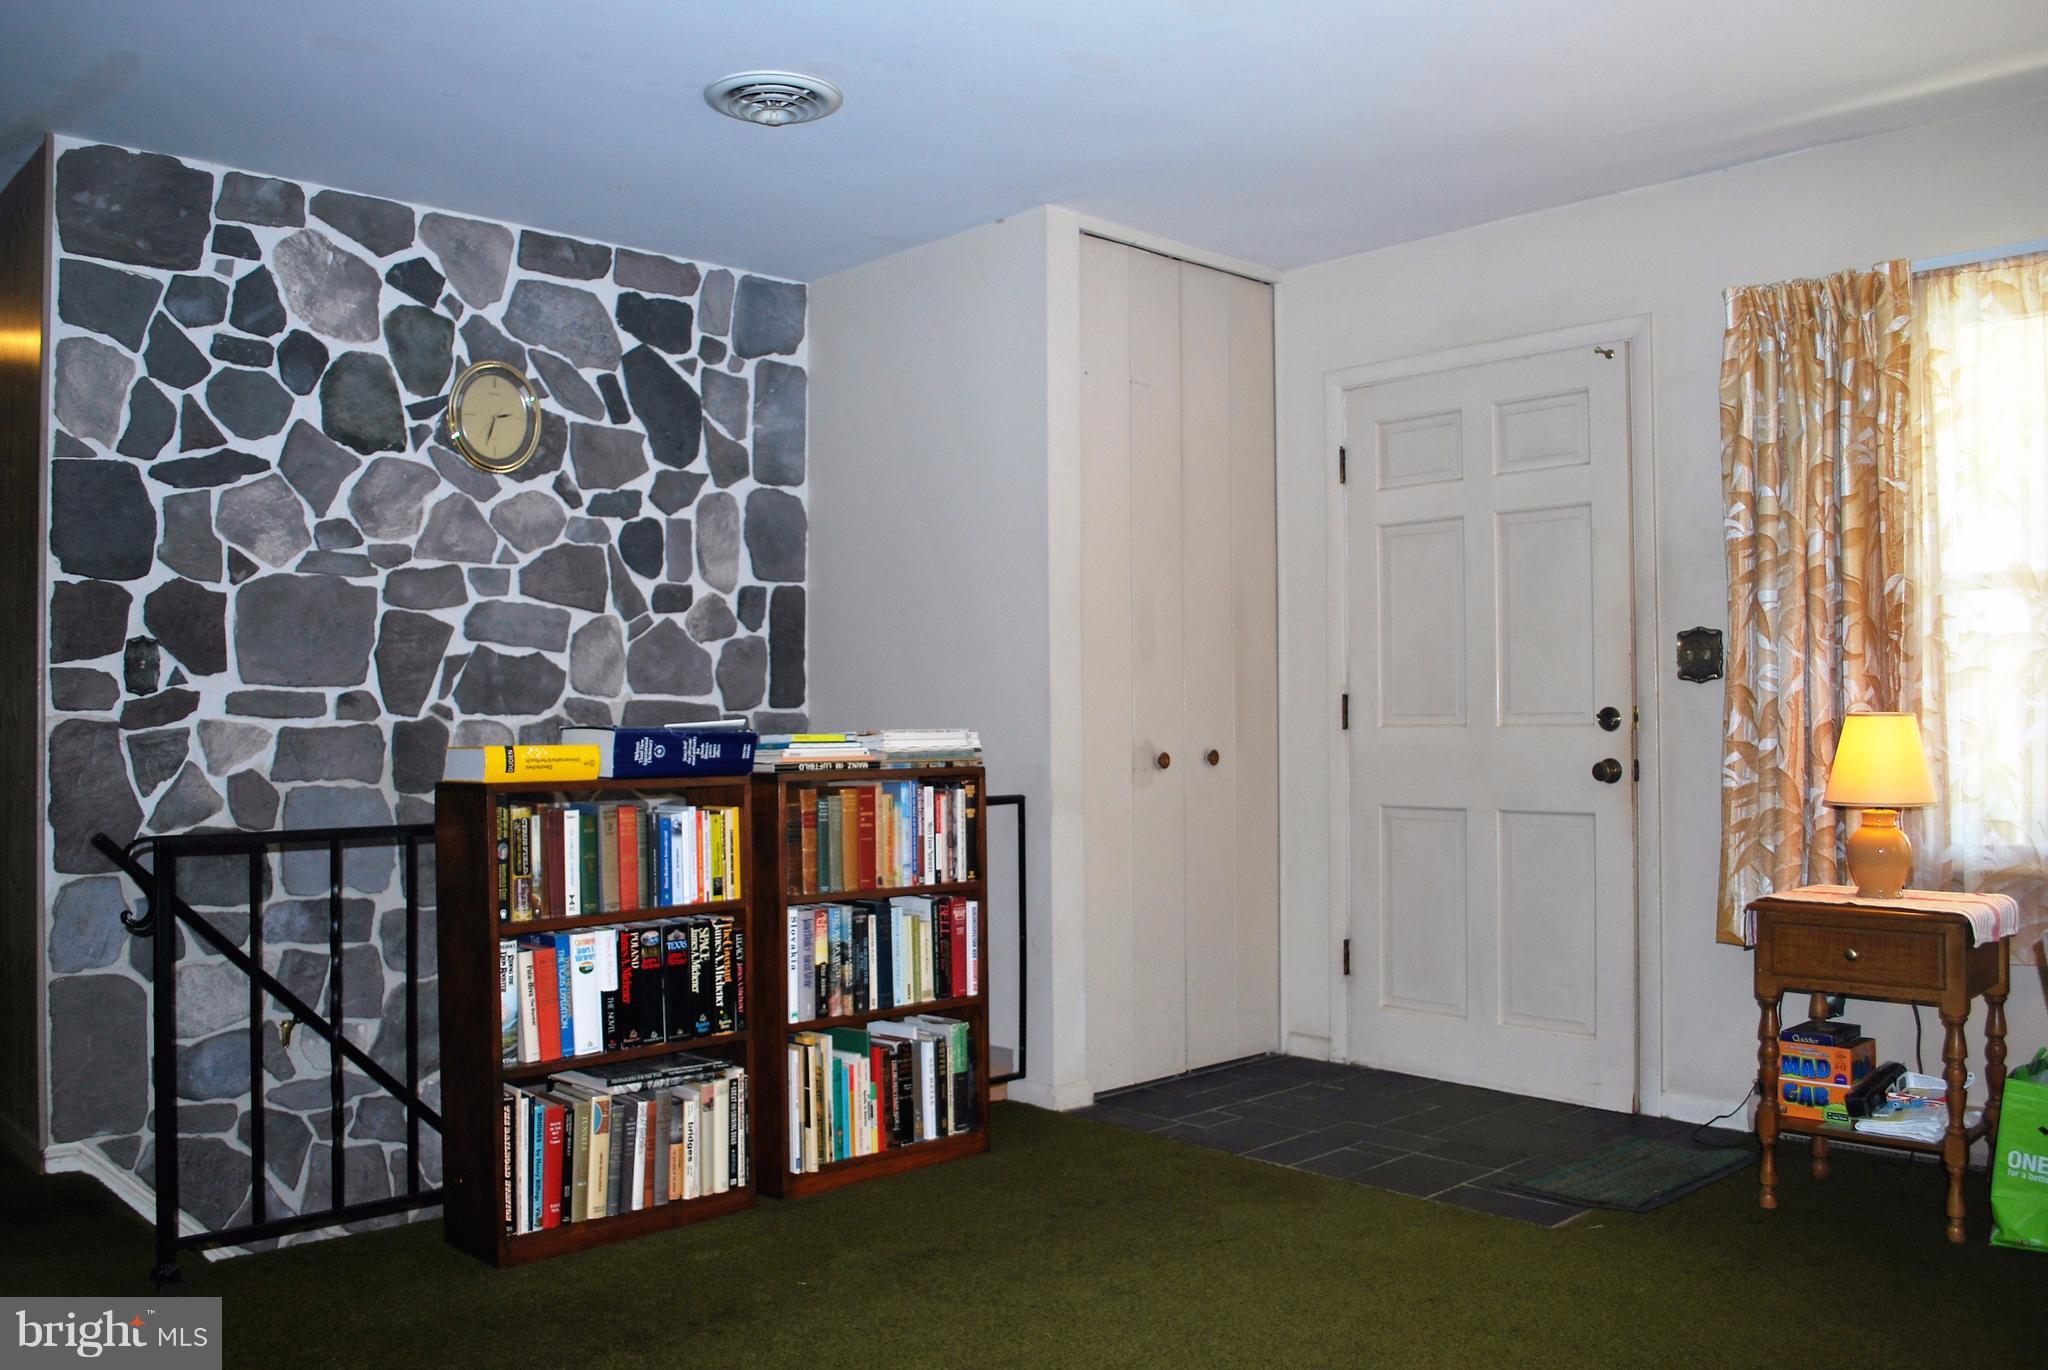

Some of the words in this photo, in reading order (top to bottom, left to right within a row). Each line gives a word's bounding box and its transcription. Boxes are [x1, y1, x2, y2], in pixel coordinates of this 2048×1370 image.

[798, 762, 832, 771] LUFTBILD
[631, 932, 639, 969] POLAND
[667, 940, 688, 950] TEXAS
[699, 928, 710, 961] SPACE
[790, 917, 798, 970] Slovakia
[692, 959, 702, 993] Michener
[716, 965, 726, 1007] Michener
[560, 988, 569, 1030] EXPEDITION
[1781, 1055, 1832, 1079] MAD
[1783, 1083, 1830, 1107] GAB
[536, 1113, 544, 1142] BRIDGES
[687, 1122, 695, 1162] bridges
[504, 1127, 512, 1177] RAILROAD
[2007, 1150, 2048, 1175] ONE
[2007, 1169, 2018, 1177] for
[505, 1180, 513, 1221] STATION
